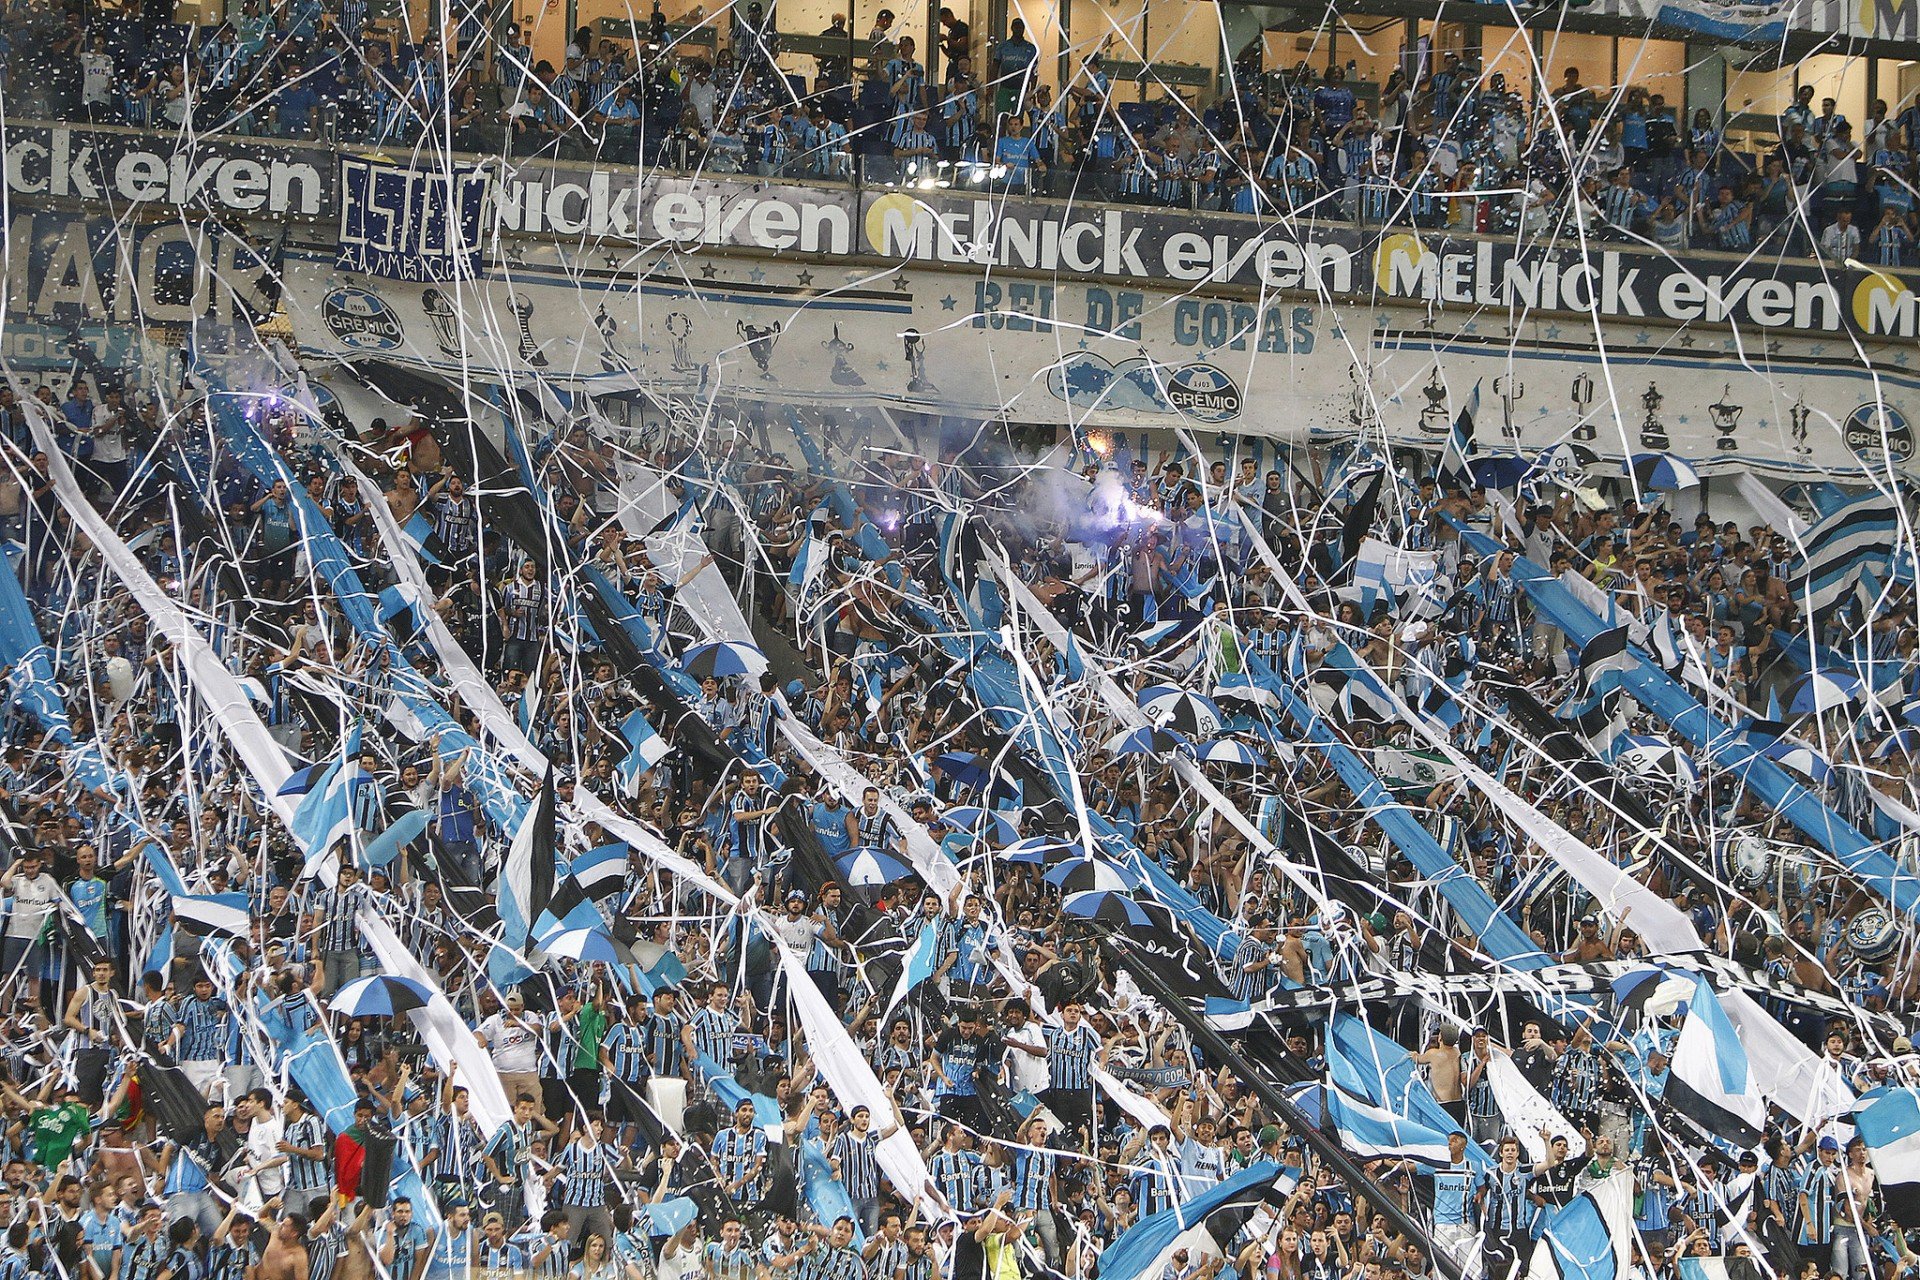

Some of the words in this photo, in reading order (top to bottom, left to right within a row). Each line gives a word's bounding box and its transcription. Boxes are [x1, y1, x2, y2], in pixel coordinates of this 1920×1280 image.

[114, 150, 322, 215] even
[652, 191, 850, 255] even
[1162, 231, 1352, 293] even
[1659, 271, 1841, 331] even
[972, 280, 1054, 335] REI
[1084, 287, 1144, 341] DE
[1173, 299, 1316, 355] COPAS
[1169, 391, 1238, 410] GRÊMIO
[1555, 457, 1568, 467] 01
[1147, 706, 1164, 721] 01
[1199, 716, 1215, 732] 89
[1632, 754, 1648, 767] 01
[1154, 1072, 1163, 1083] A
[1194, 1161, 1218, 1172] RENN
